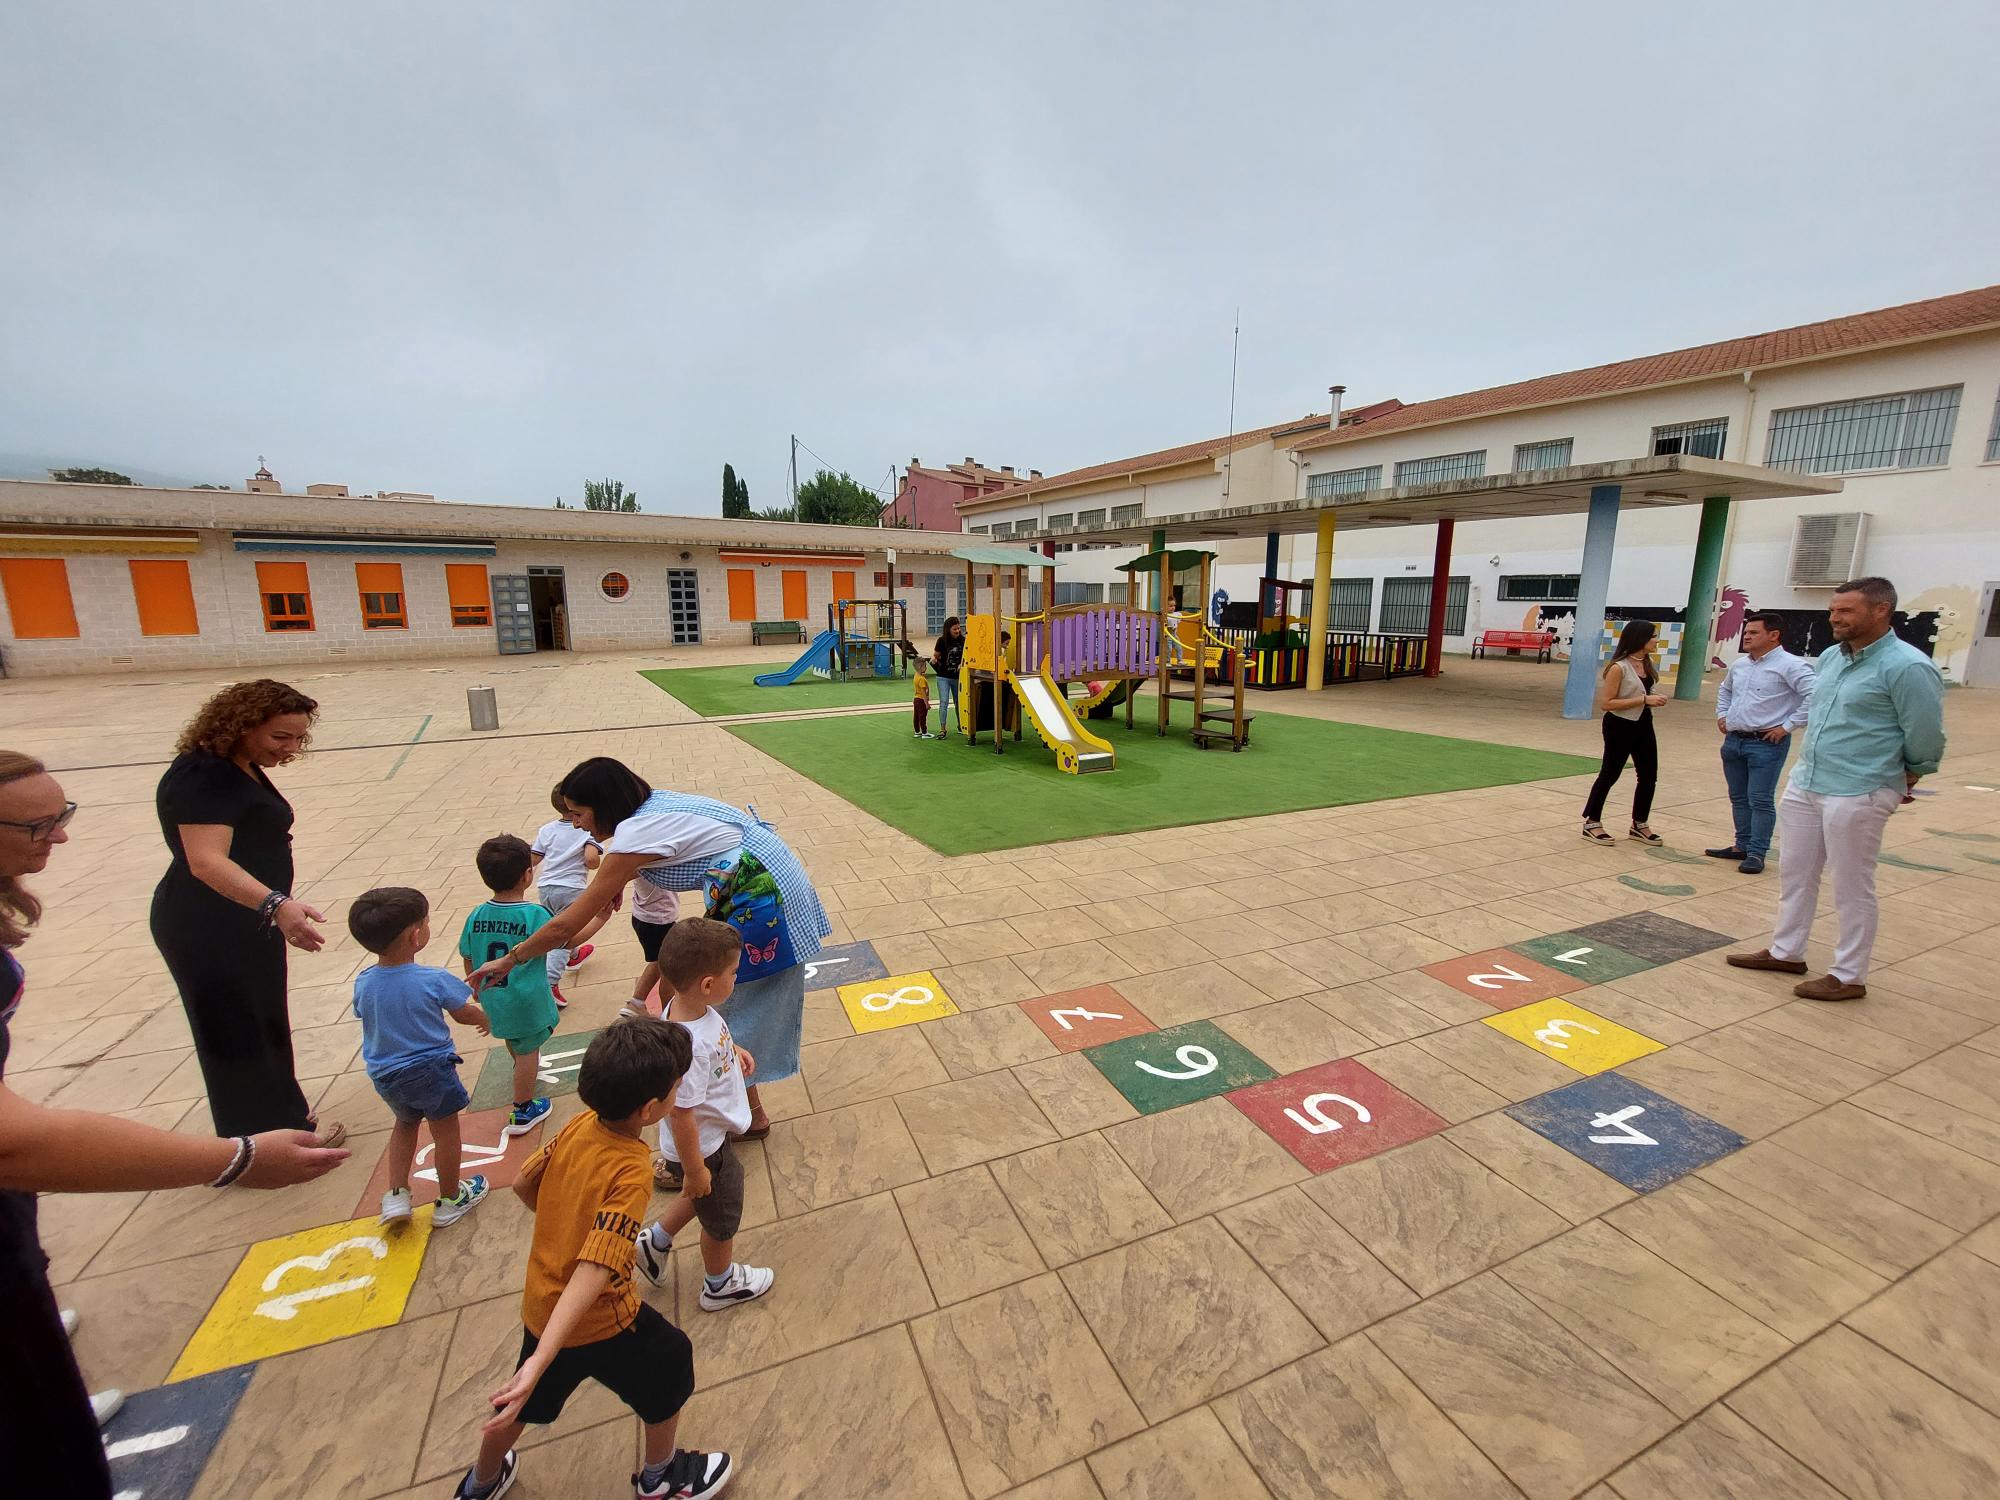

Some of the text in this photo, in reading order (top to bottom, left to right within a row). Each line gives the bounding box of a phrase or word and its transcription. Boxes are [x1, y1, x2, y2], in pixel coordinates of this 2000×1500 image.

[473, 920, 527, 937] BENZEMA
[1552, 947, 1594, 965] 1
[1467, 964, 1533, 989] 2
[861, 985, 934, 1012] 8
[1050, 1006, 1123, 1030] 7
[1534, 1019, 1600, 1049] 3
[1134, 1045, 1219, 1080] 6
[1283, 1092, 1372, 1135] 5
[1587, 1105, 1660, 1146] 4
[412, 1126, 510, 1183] 12
[591, 1210, 641, 1246] NIKE
[253, 1236, 389, 1320] 13
